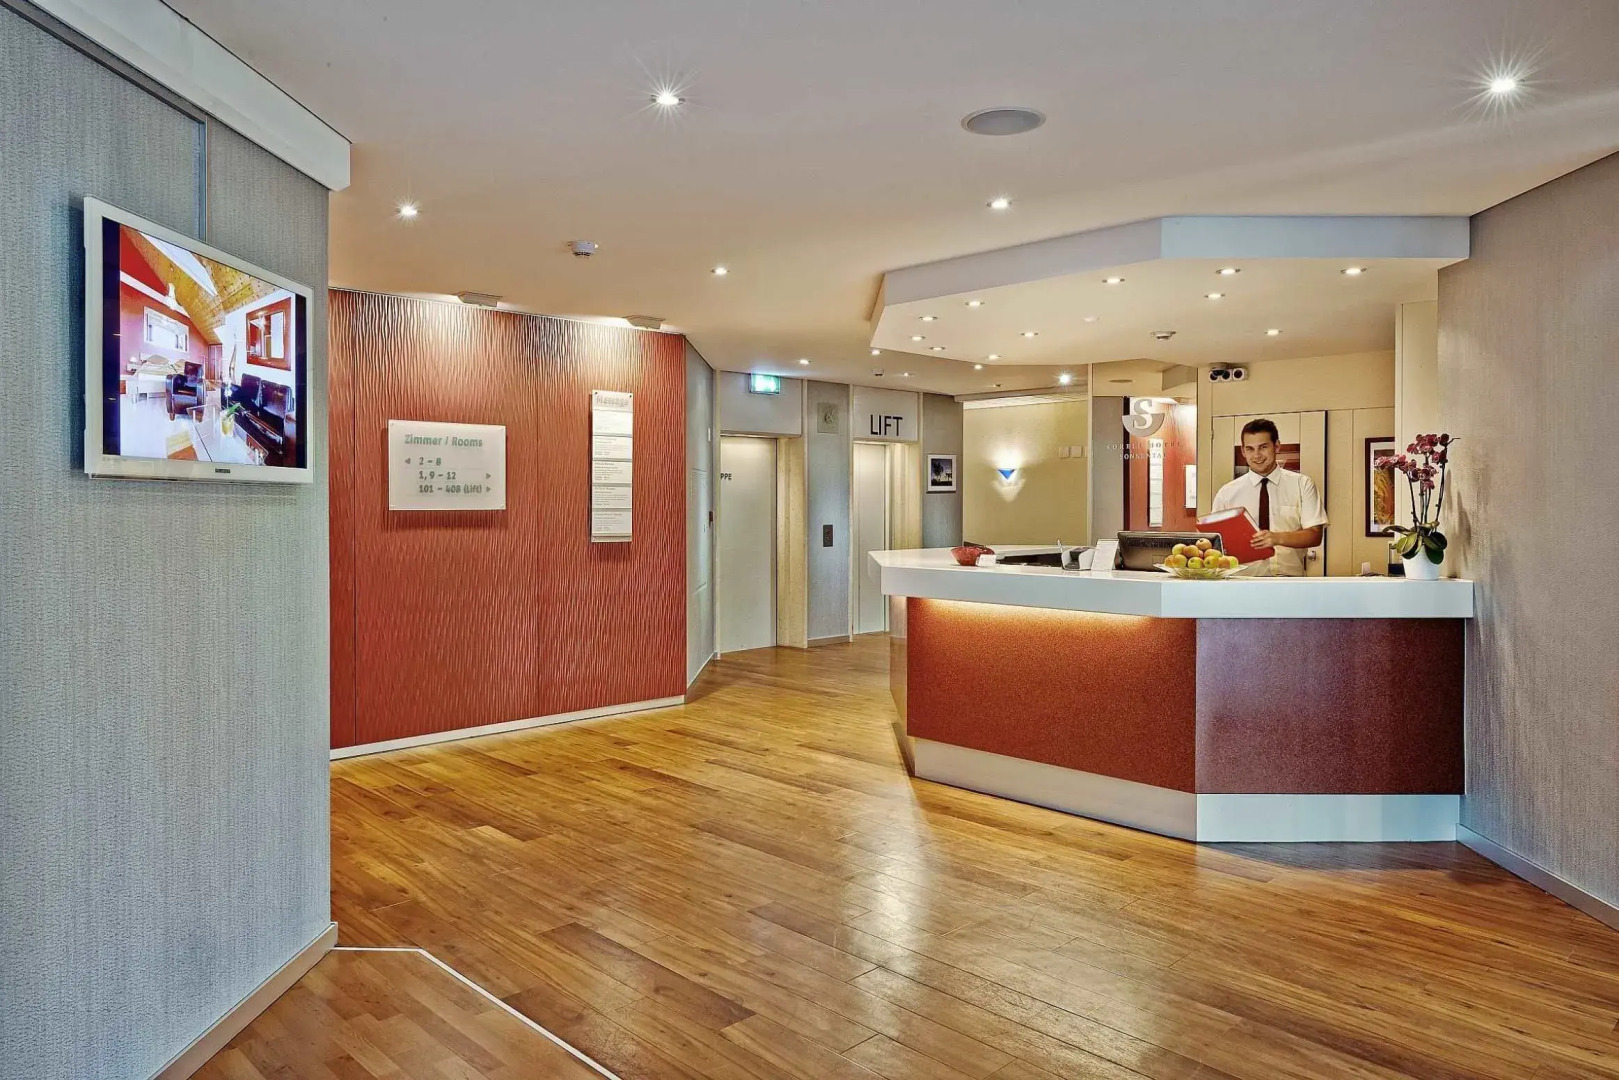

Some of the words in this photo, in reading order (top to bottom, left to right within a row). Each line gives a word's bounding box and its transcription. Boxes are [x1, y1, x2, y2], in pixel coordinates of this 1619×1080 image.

[870, 414, 903, 436] LIFT
[404, 434, 442, 446] Zimmer
[451, 437, 483, 447] Rooms
[418, 457, 424, 466] 2
[435, 457, 442, 466] 8
[446, 471, 456, 480] 12
[418, 485, 434, 493] 101
[445, 485, 461, 493] 408
[463, 484, 482, 494] (Lift)
